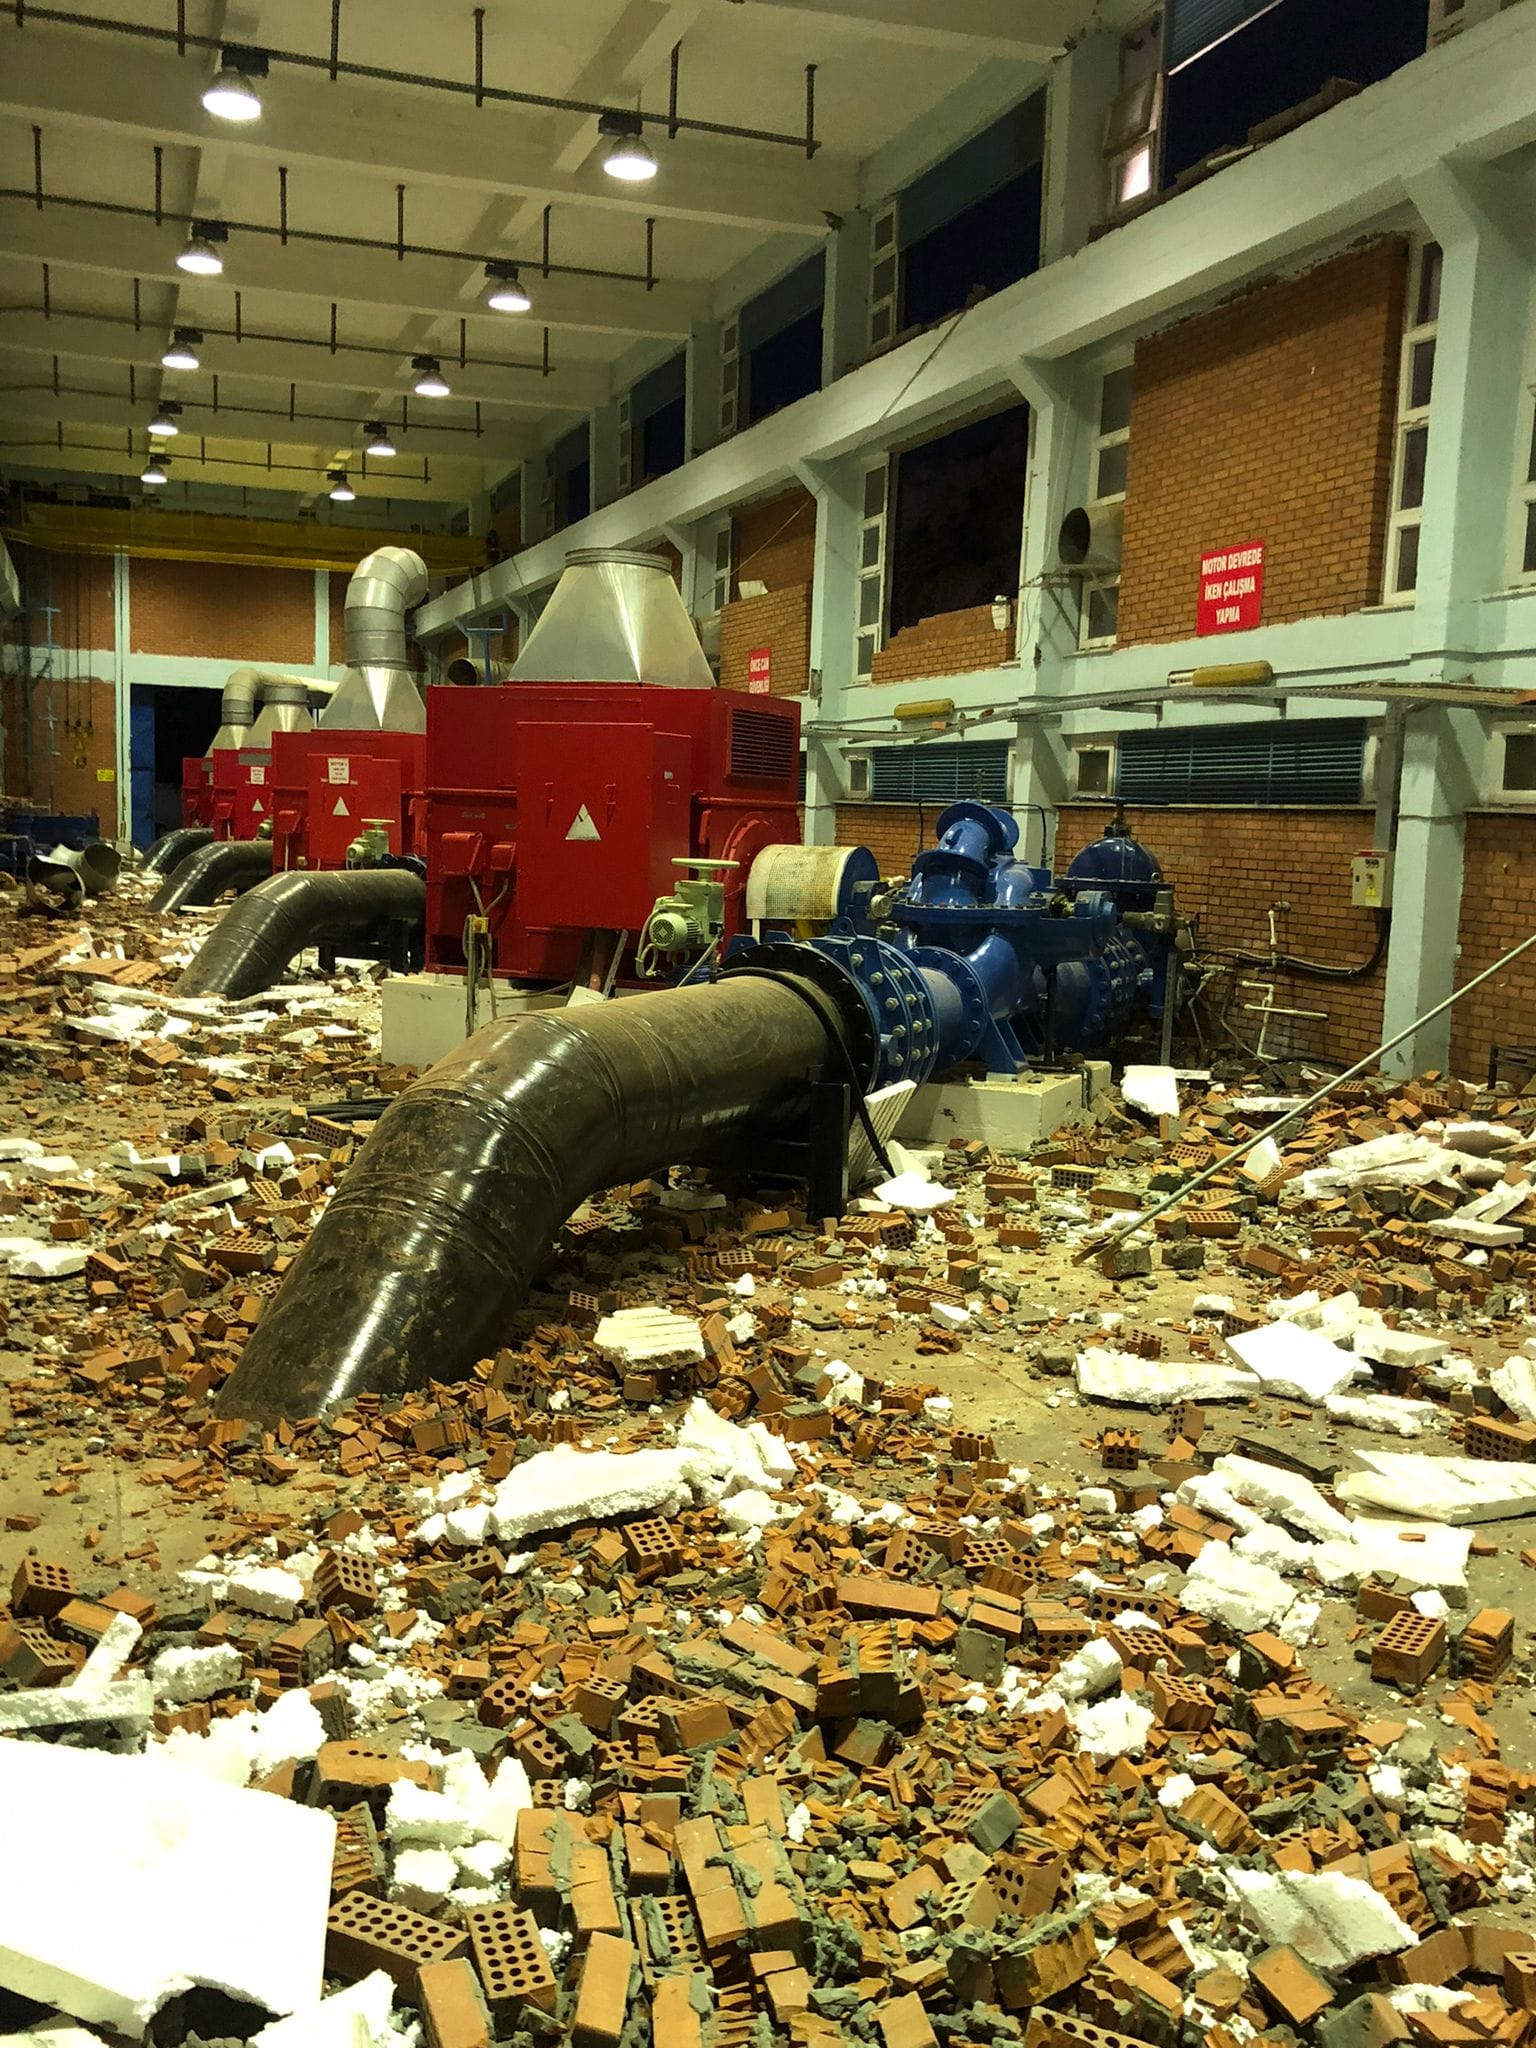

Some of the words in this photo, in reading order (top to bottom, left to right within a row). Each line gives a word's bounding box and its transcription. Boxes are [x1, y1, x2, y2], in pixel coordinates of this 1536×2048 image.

[1202, 555, 1227, 576] MOTOR
[1228, 548, 1263, 570] DEVREDE
[1205, 582, 1223, 601] İKEN
[1223, 576, 1255, 601] ÇALIŞMA
[1216, 606, 1240, 625] YAPMA
